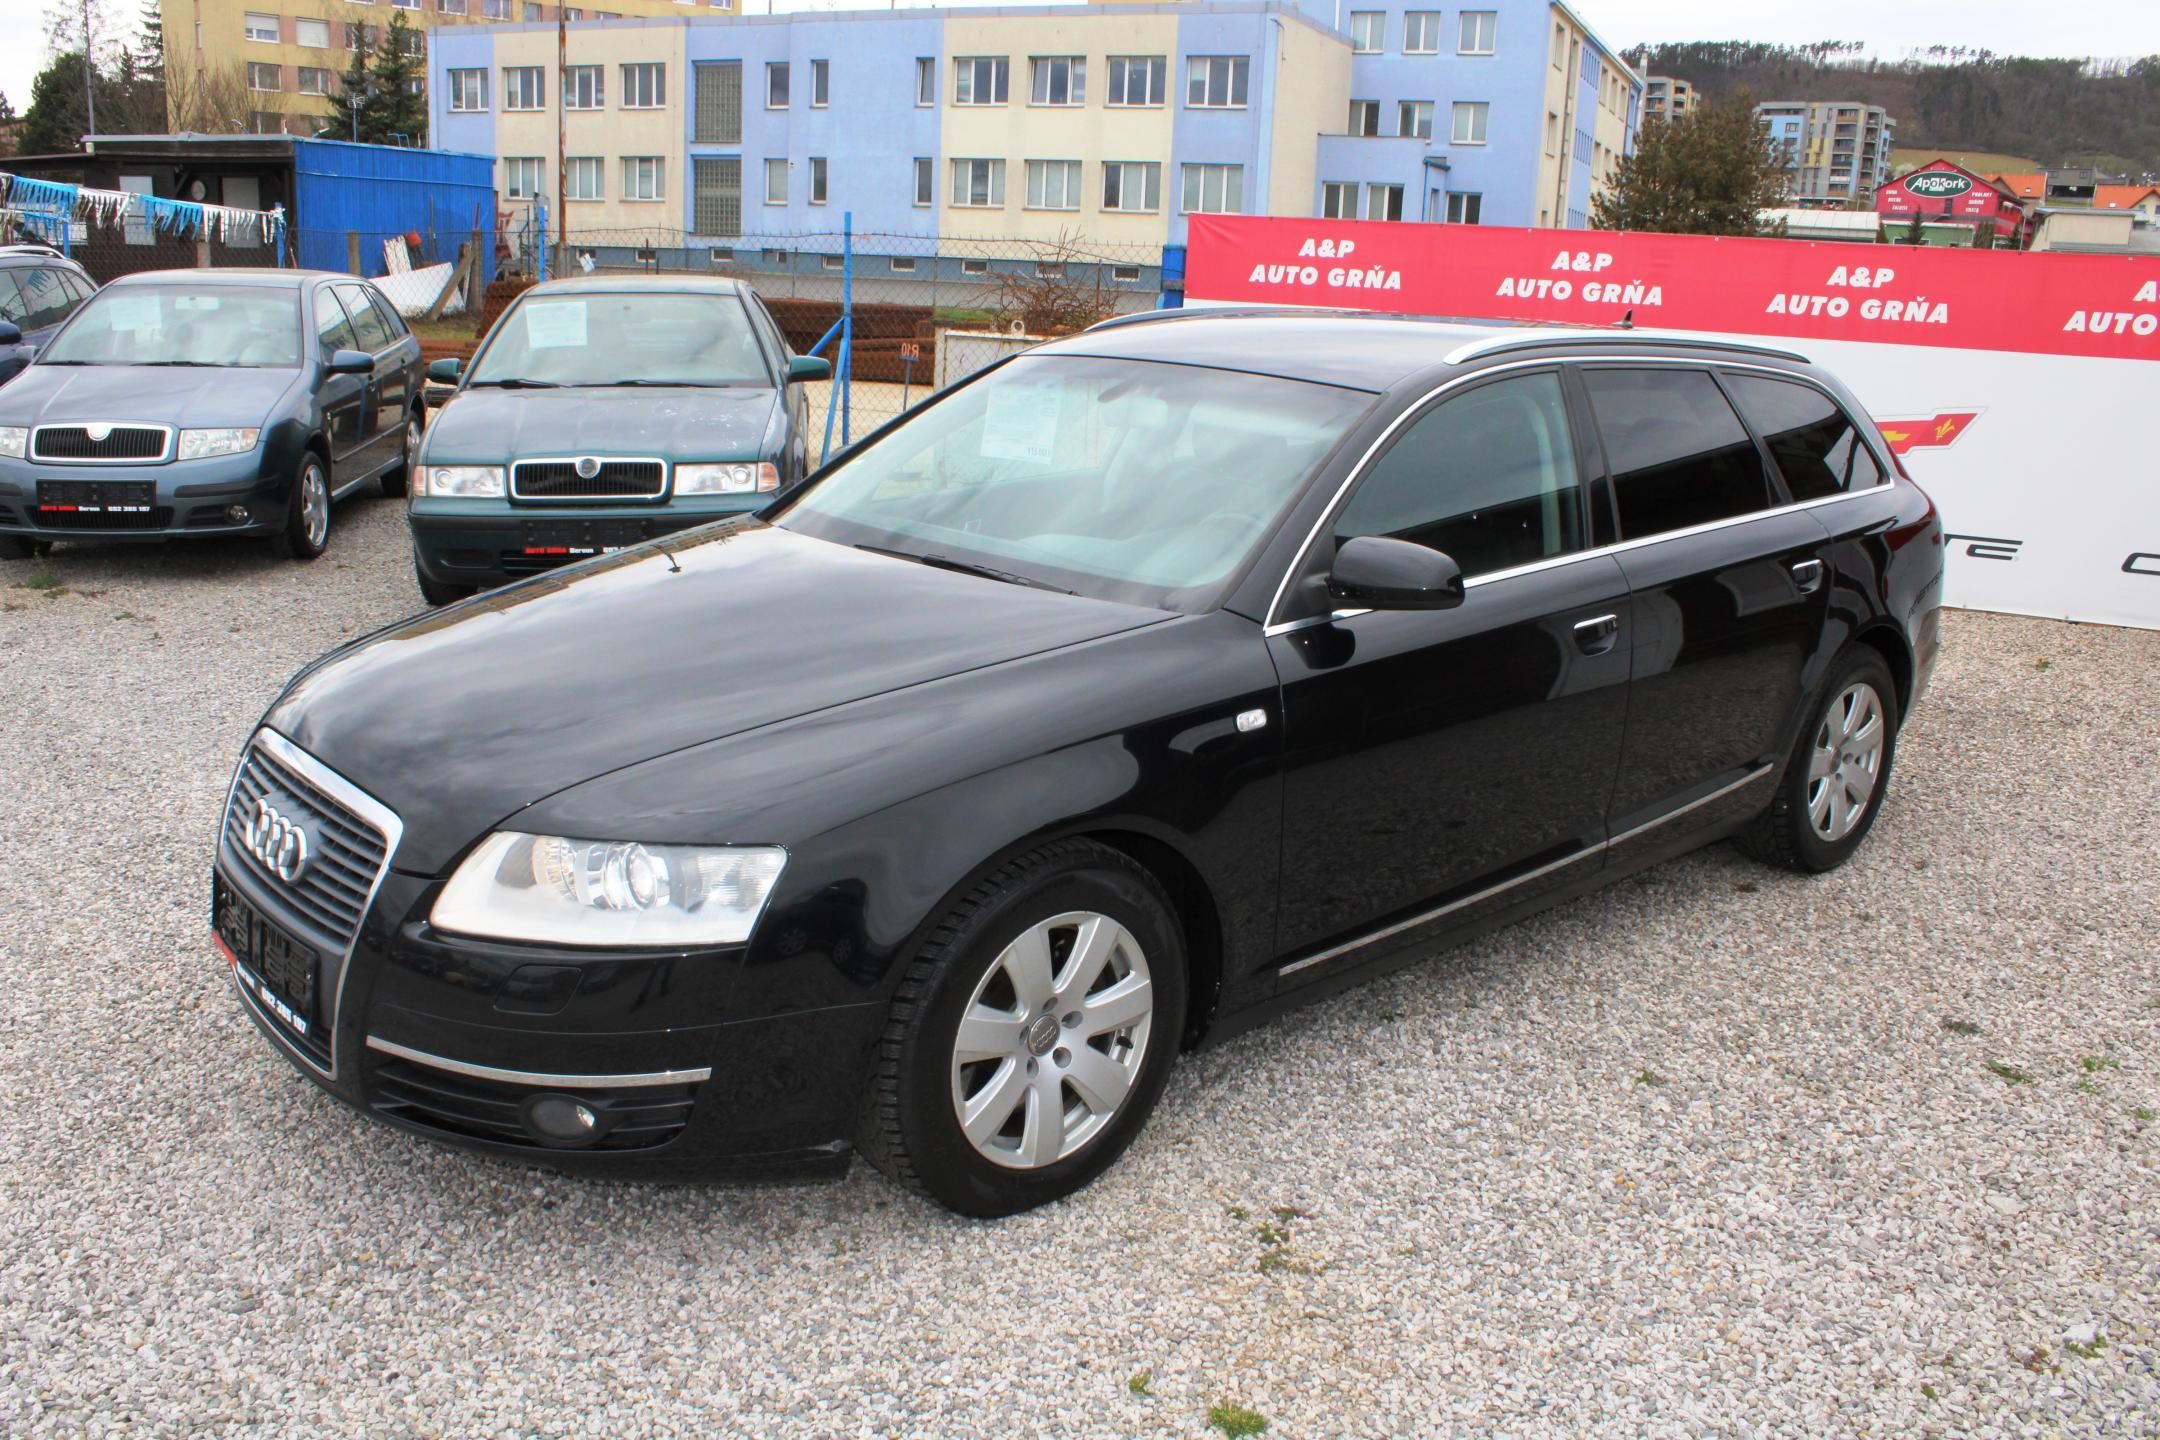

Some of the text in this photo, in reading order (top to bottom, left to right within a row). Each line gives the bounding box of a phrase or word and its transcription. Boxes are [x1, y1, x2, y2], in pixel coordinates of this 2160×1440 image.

[1299, 238, 1355, 259] A&P
[1551, 250, 1613, 273] A&P
[1249, 264, 1401, 290] AUTO GRŇA
[1826, 266, 1895, 289] A&P
[1496, 278, 1662, 306] AUTO GRŇA
[2133, 280, 2160, 303] A
[1766, 293, 1948, 323] AUTO GRŇA
[2063, 310, 2158, 336] AUTO
